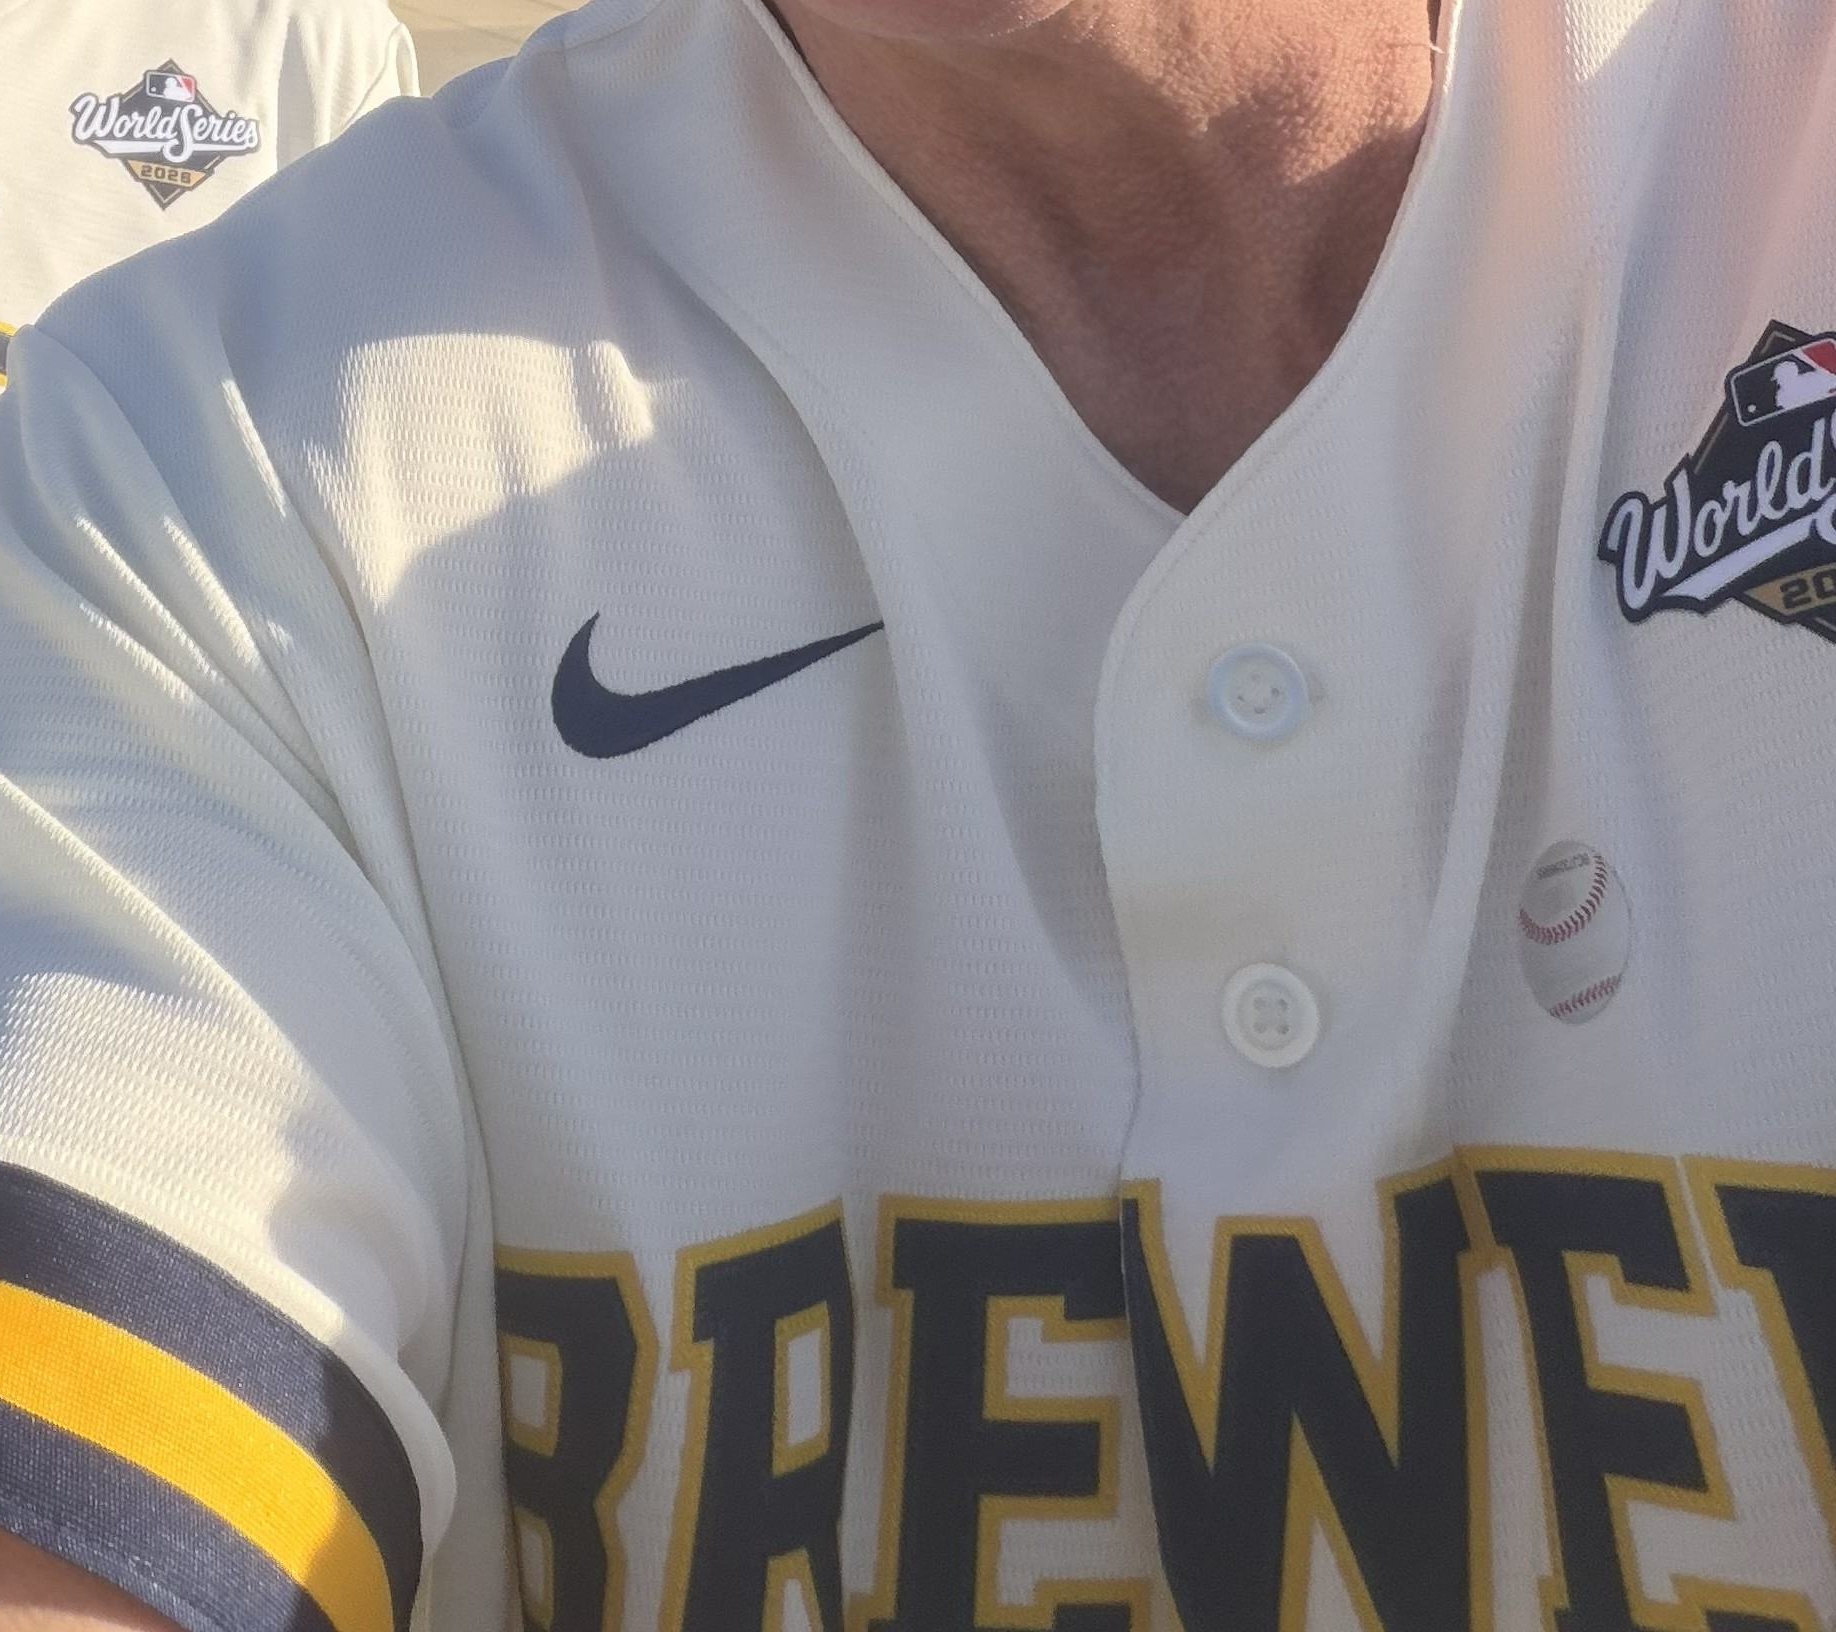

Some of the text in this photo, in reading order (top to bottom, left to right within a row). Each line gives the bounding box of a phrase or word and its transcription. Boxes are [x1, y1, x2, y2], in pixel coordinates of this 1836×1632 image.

[75, 94, 259, 163] World Series
[1608, 417, 1836, 612] World
[494, 1141, 1836, 1632] BREWE
